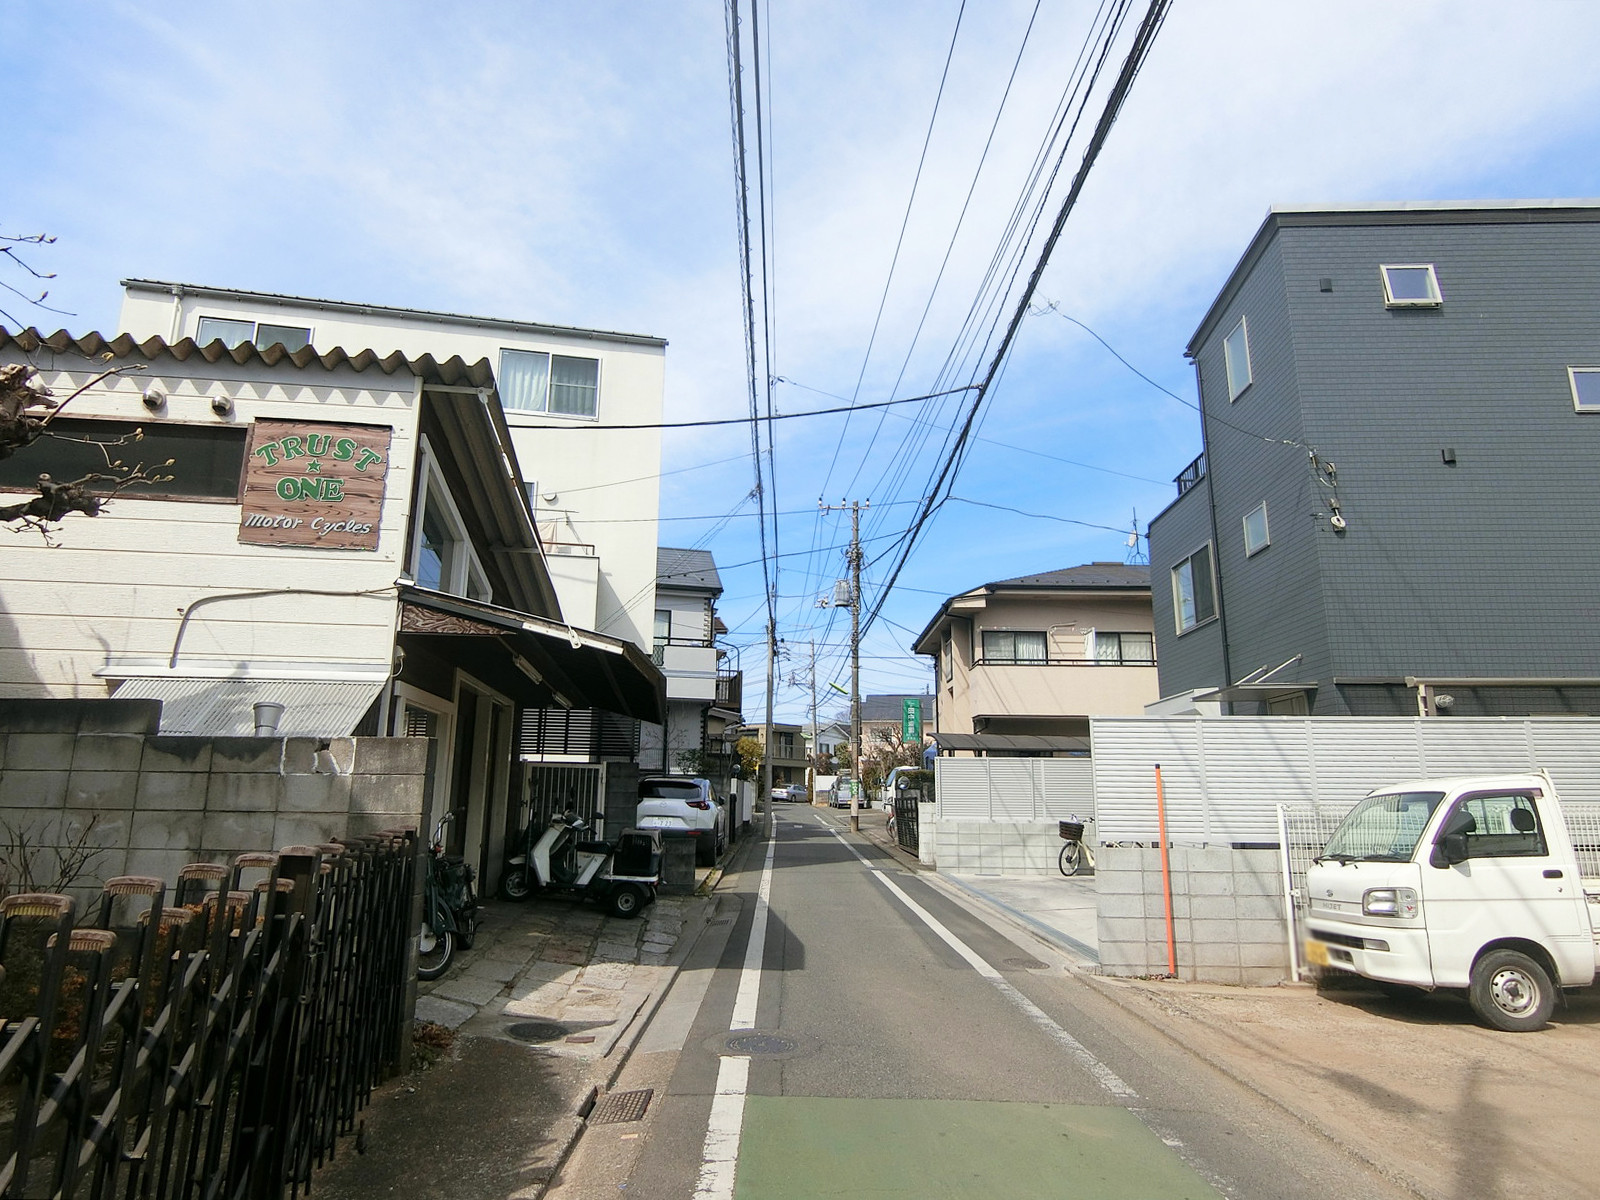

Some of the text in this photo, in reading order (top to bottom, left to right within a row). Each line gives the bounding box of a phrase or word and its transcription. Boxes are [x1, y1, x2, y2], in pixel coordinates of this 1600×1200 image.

[255, 433, 382, 472] TRUST
[276, 476, 345, 502] ONE
[244, 512, 373, 537] Motor Cycles
